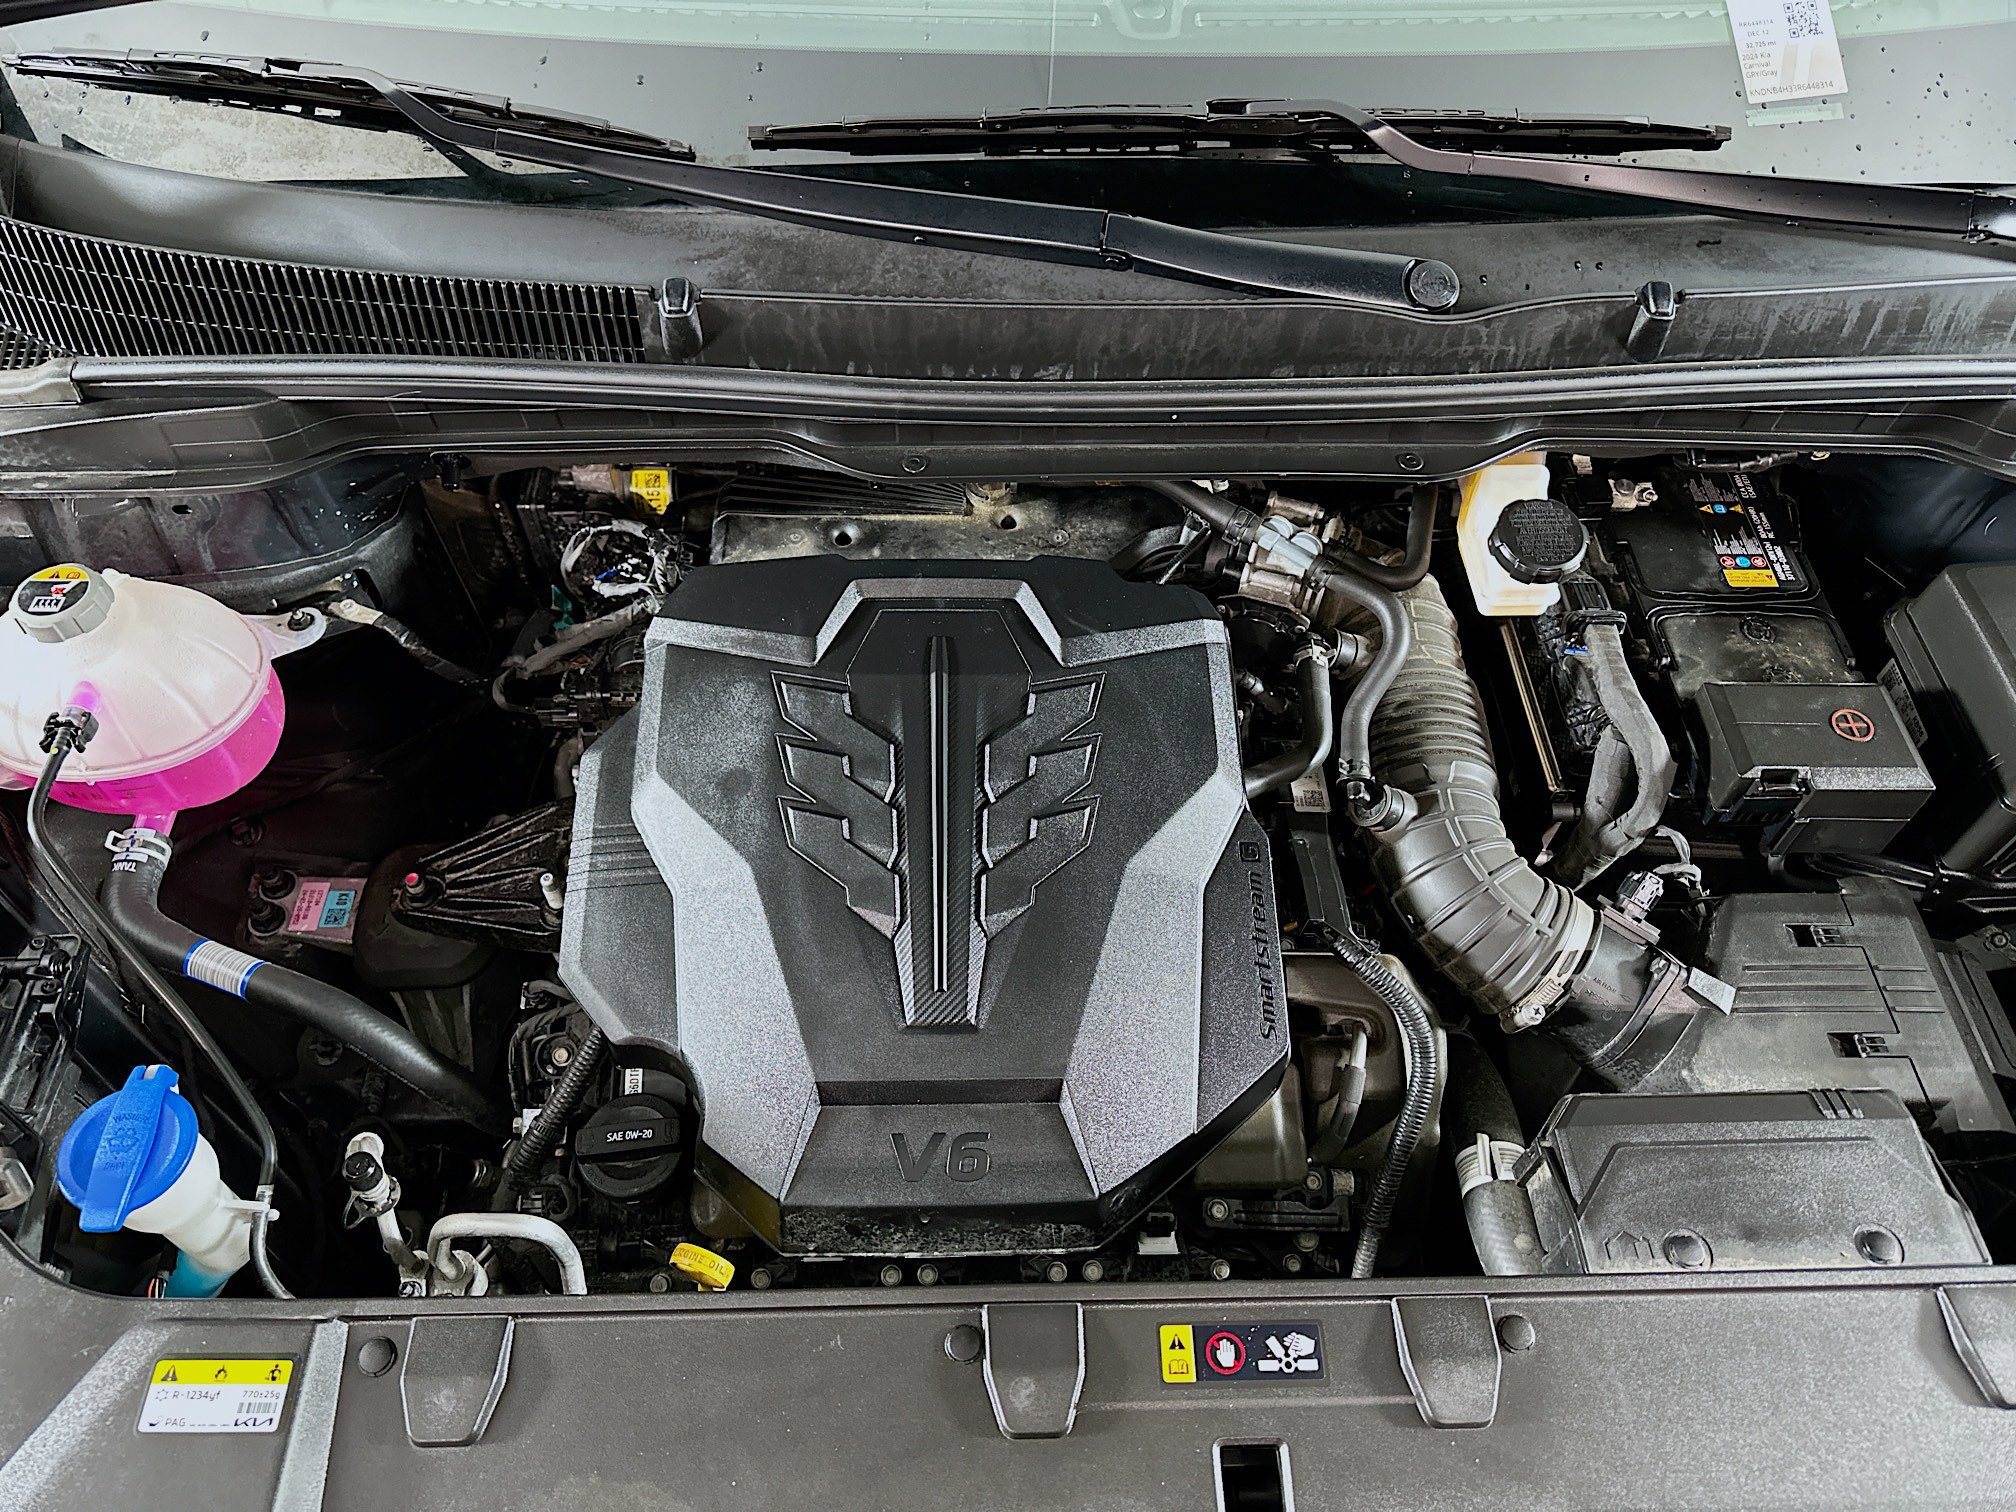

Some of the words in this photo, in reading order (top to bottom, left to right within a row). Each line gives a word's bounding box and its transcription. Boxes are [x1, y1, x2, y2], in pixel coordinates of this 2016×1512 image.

[1743, 61, 1771, 69] Carnival
[1746, 70, 1778, 79] GRY/Gray
[111, 861, 137, 872] TANK
[1249, 870, 1279, 1043] Smartstream
[606, 1132, 623, 1142] SAE
[625, 1129, 653, 1140] 0W-20
[889, 1131, 991, 1183] V6
[708, 1260, 724, 1275] OIL
[171, 1390, 221, 1402] R-1234yf
[242, 1390, 281, 1399] 770±25g
[164, 1417, 186, 1427] PAG
